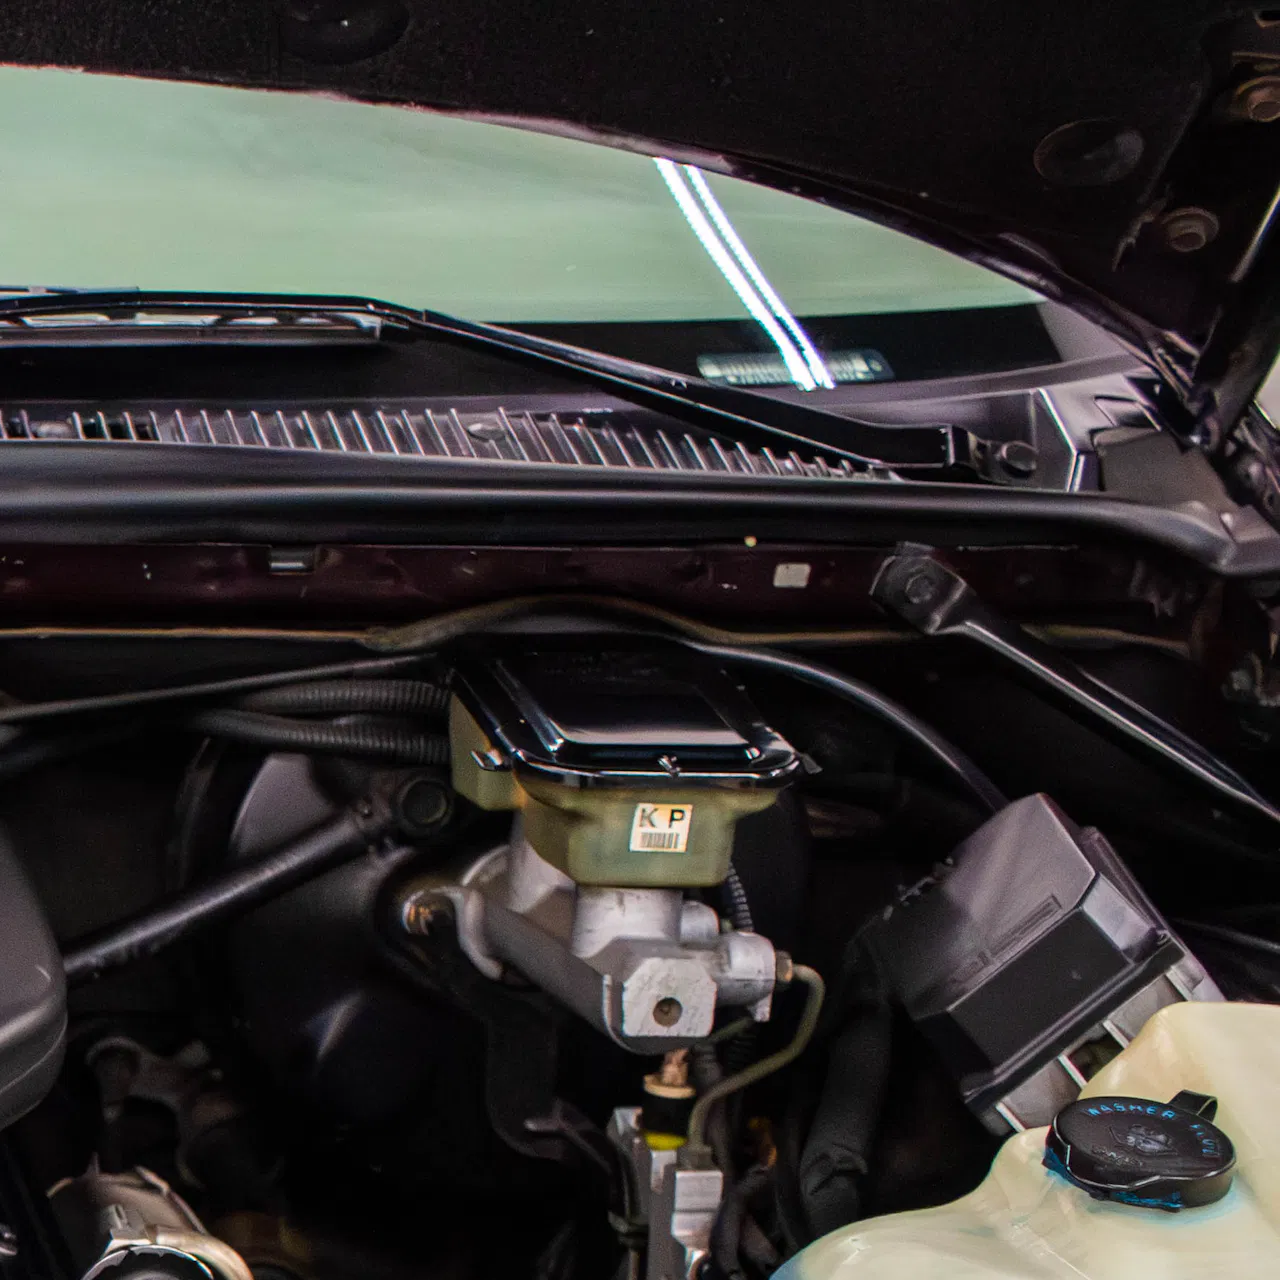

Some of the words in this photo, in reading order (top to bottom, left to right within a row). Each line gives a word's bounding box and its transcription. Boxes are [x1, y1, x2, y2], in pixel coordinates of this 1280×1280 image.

[638, 808, 657, 828] K
[668, 808, 686, 829] P
[1086, 1102, 1177, 1120] WASHER
